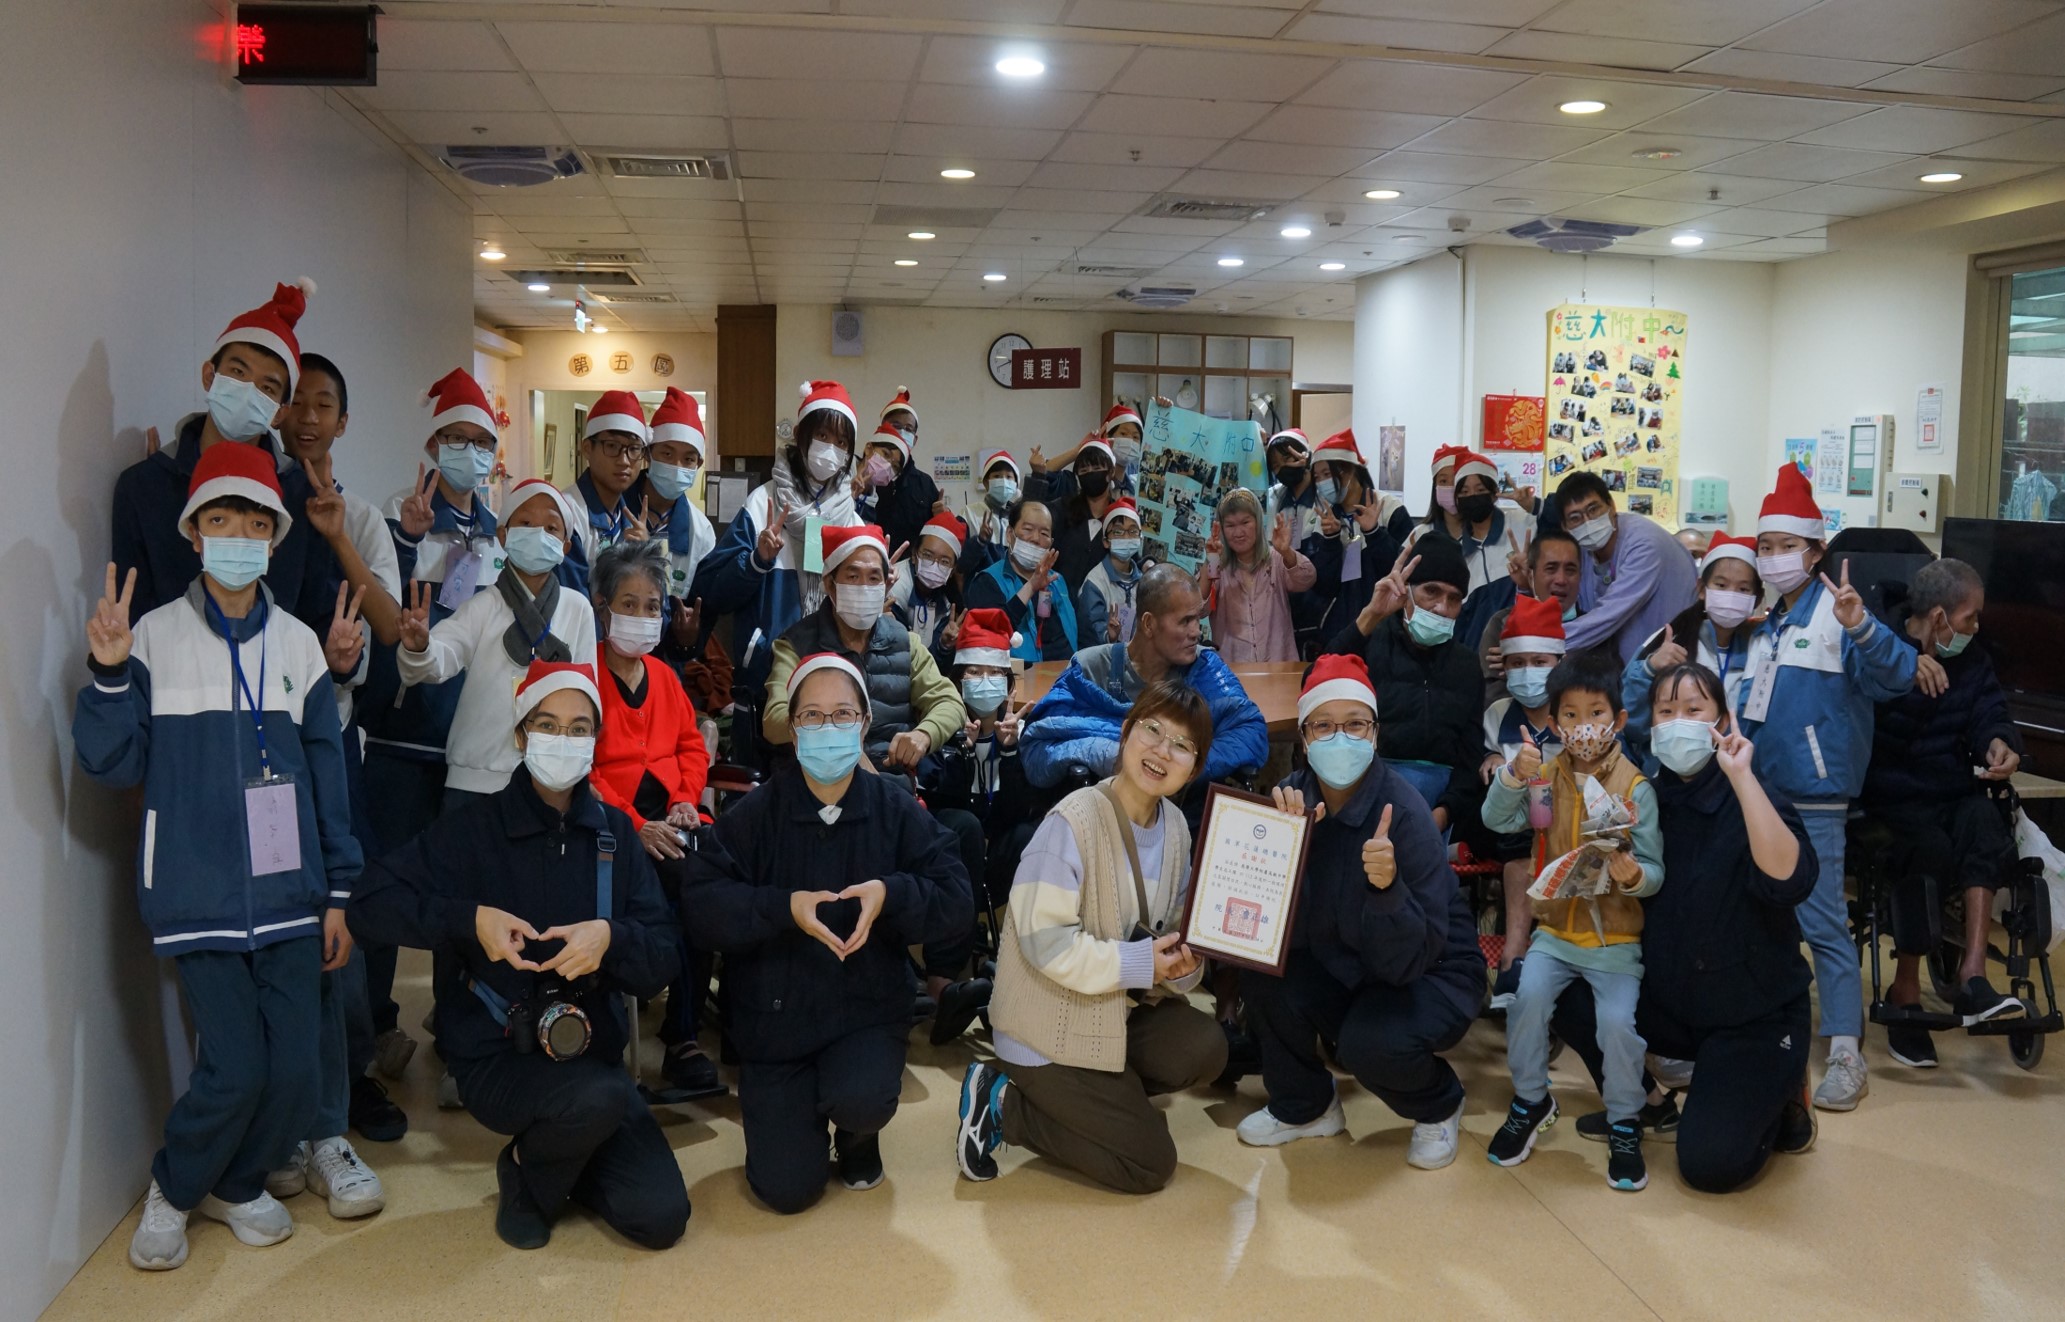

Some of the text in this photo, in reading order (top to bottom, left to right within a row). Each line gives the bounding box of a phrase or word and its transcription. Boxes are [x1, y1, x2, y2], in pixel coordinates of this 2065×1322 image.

[1022, 358, 1070, 381] 護理站
[1148, 410, 1255, 461] 慈大附中
[1522, 462, 1537, 476] 28
